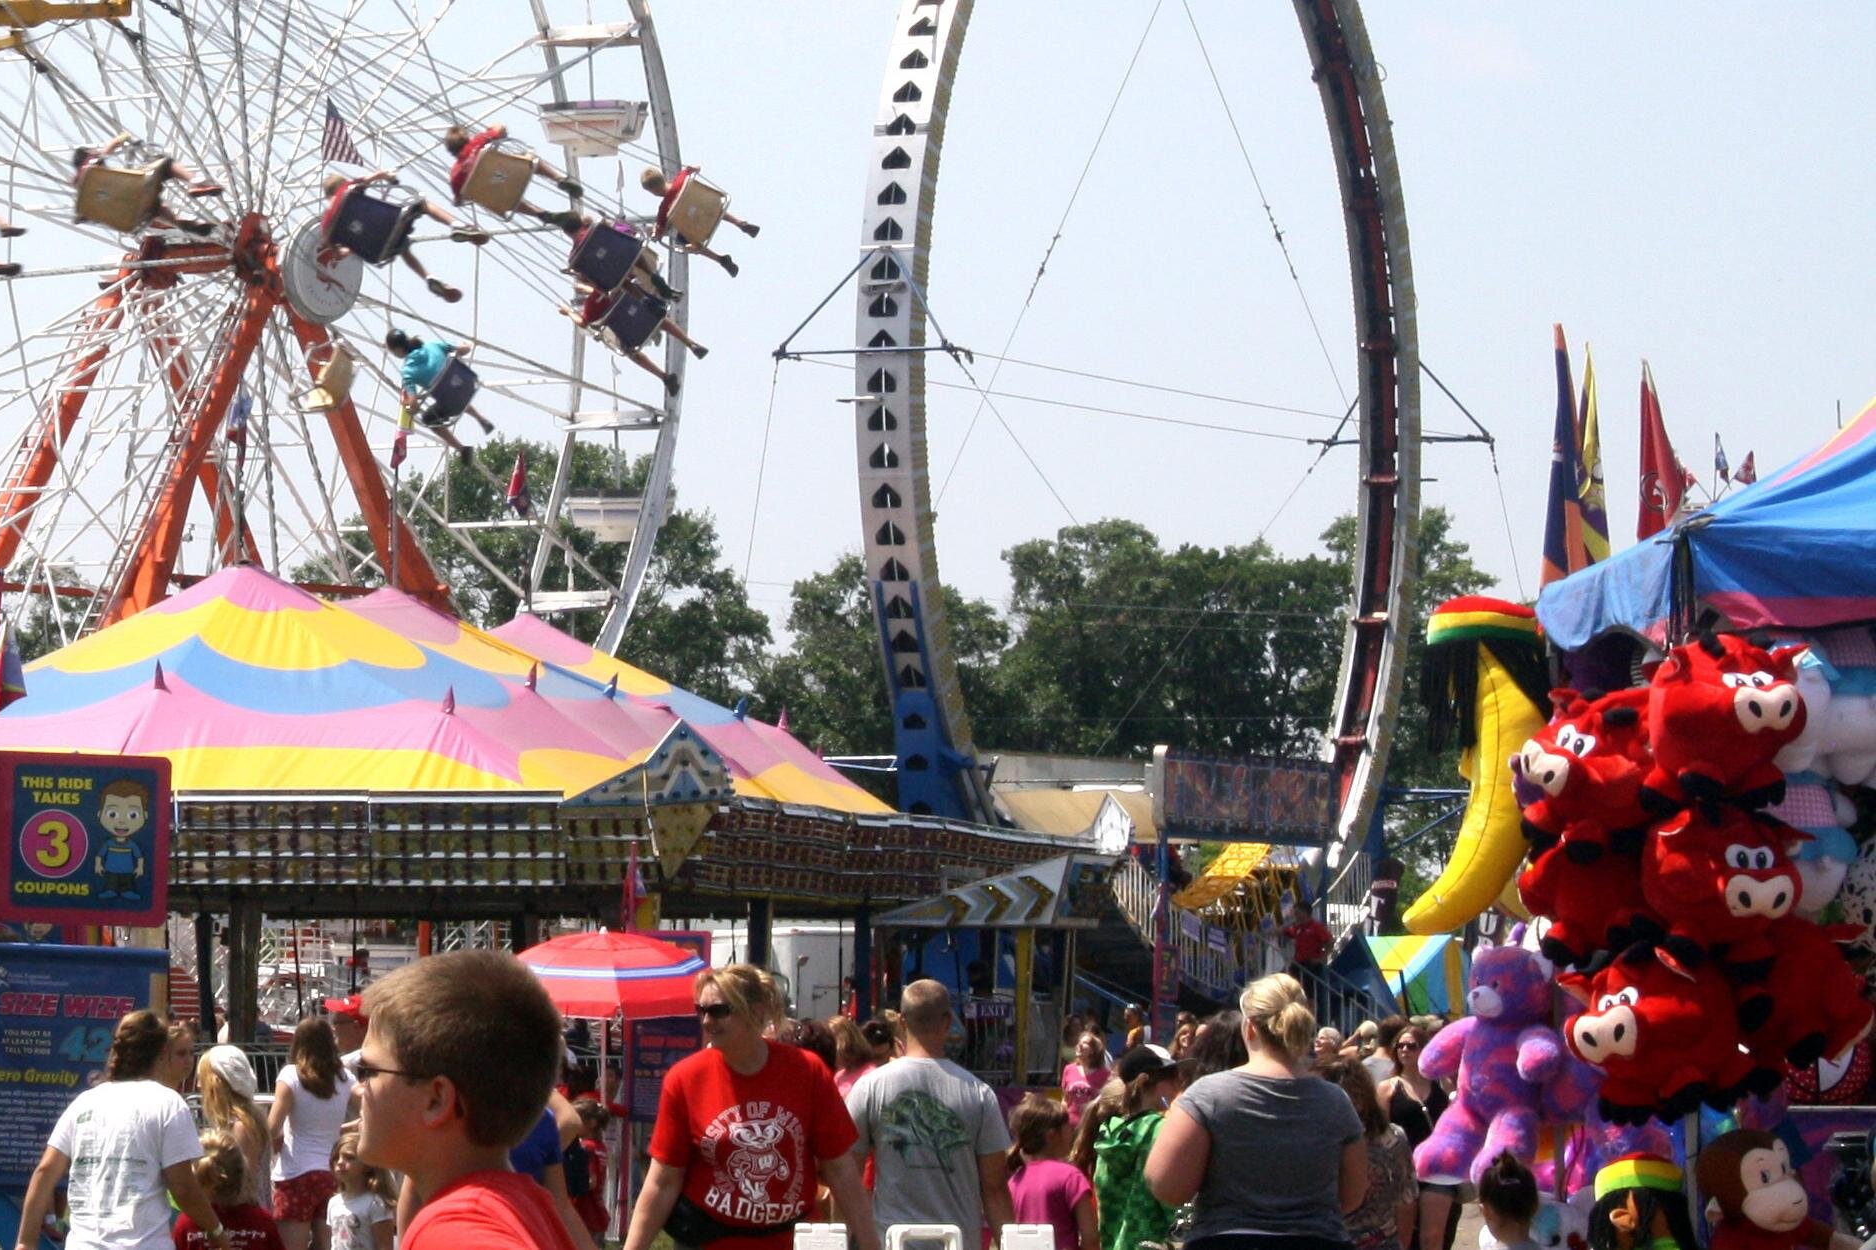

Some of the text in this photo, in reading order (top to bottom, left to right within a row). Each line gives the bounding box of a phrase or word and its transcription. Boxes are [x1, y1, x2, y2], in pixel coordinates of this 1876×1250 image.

[21, 776, 93, 790] THIS RIDE
[32, 792, 80, 805] TAKES
[35, 820, 70, 868] 3
[14, 881, 90, 896] COUPONS
[63, 994, 135, 1019] WIZE
[24, 1068, 80, 1087] Gravity
[746, 1101, 771, 1119] OF
[704, 1186, 805, 1224] BADGERS
